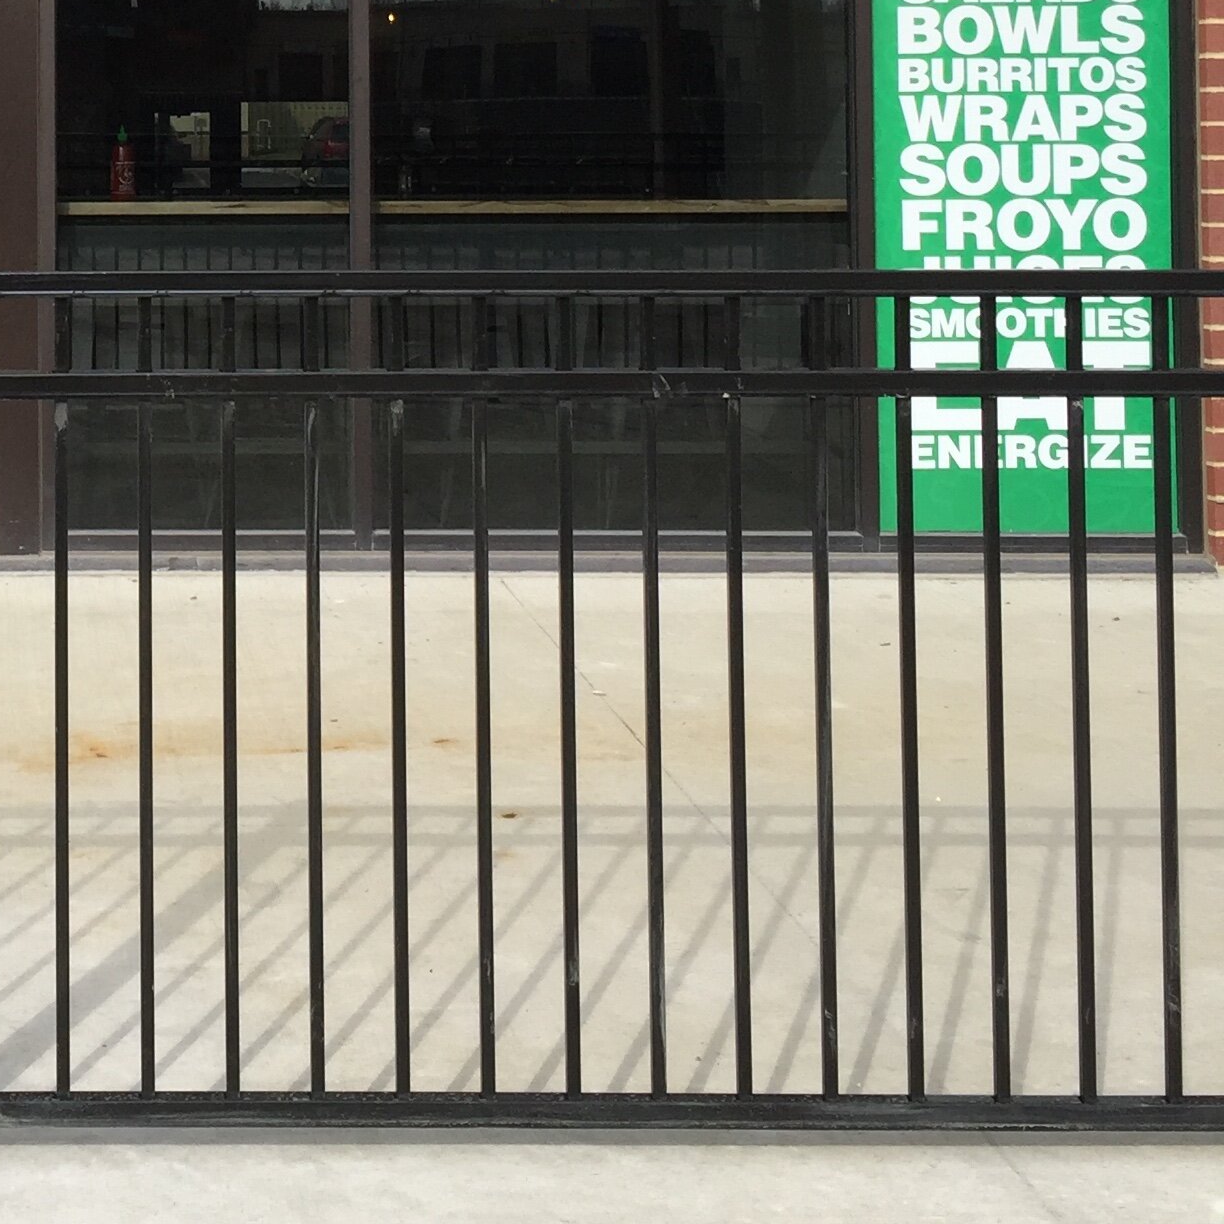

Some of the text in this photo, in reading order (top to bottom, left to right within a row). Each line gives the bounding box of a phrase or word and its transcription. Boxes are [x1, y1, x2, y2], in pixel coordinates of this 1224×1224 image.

[897, 4, 1146, 55] BOWLS
[898, 56, 1147, 93] BURRITOS
[899, 93, 1147, 142] WRAPS
[899, 142, 1148, 197] SOUPS
[901, 197, 1148, 251] FROYO
[909, 340, 1152, 431] EAT
